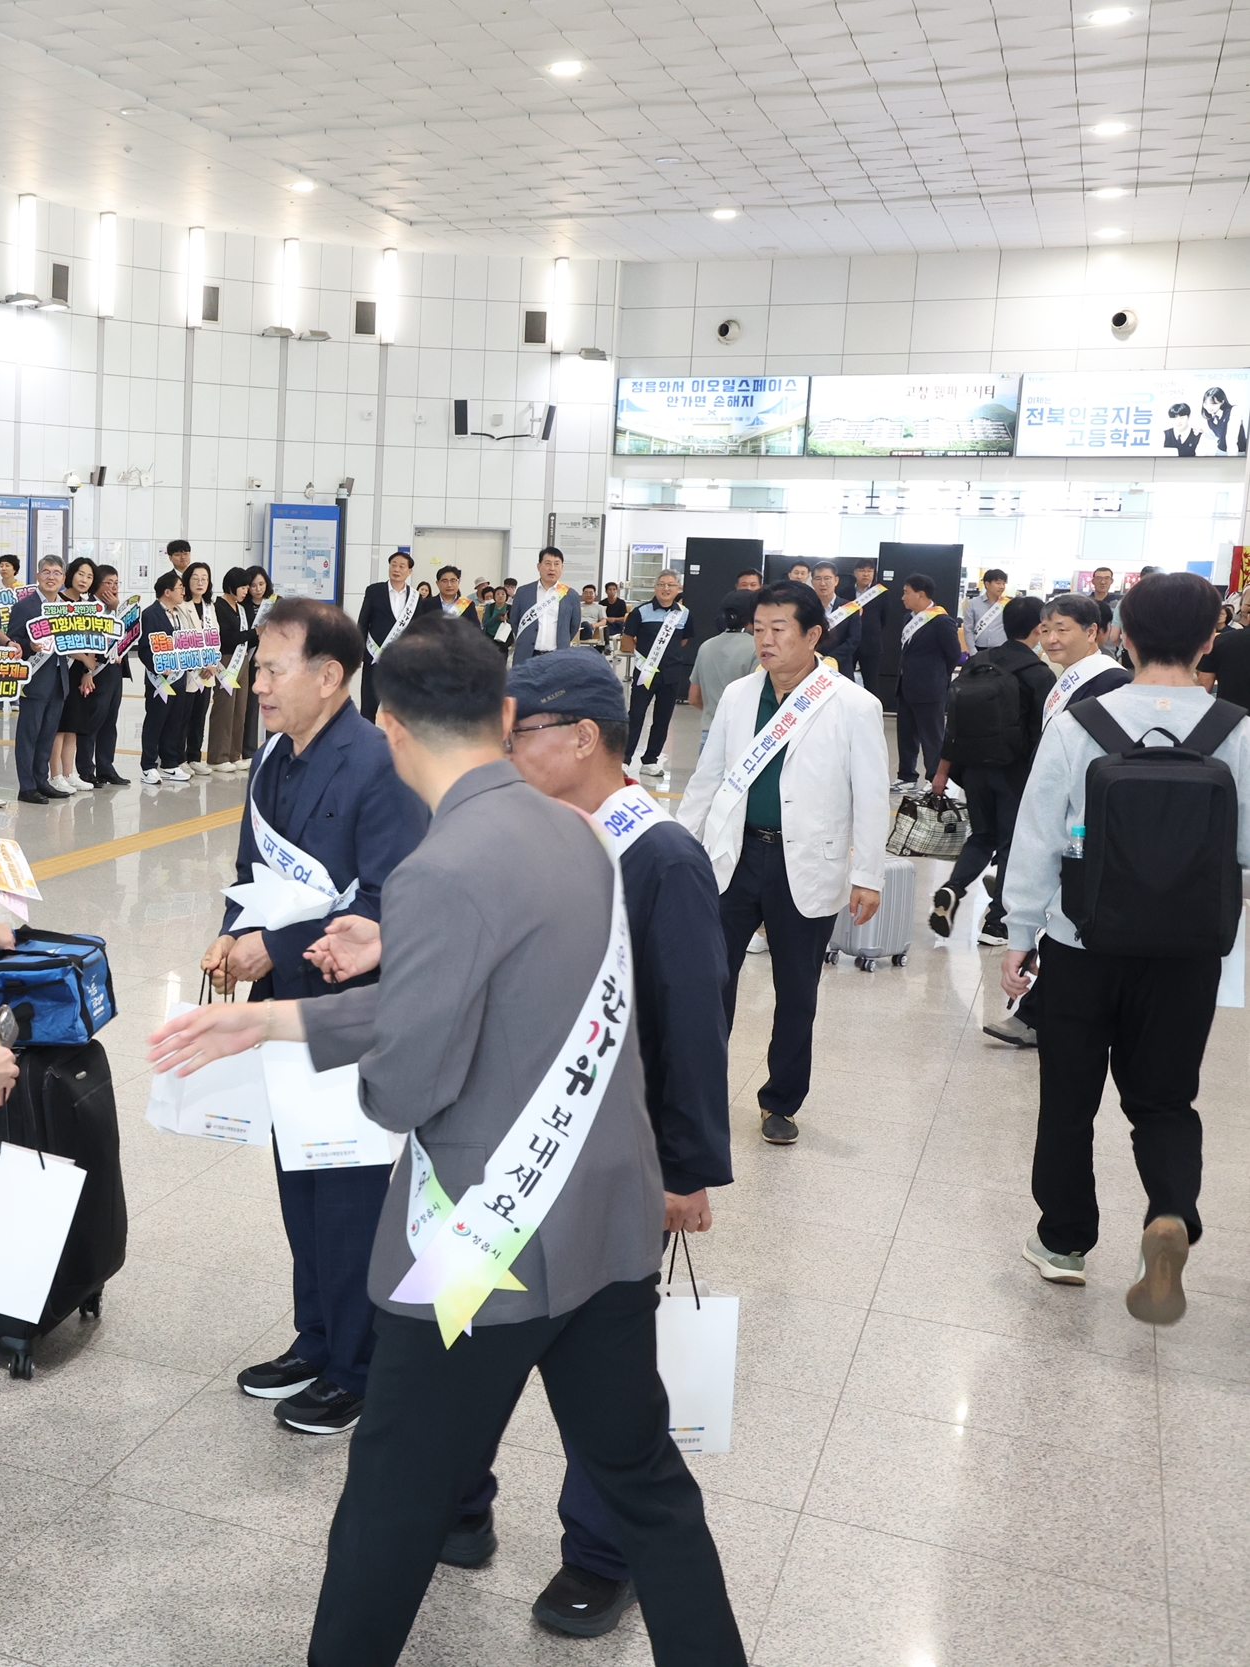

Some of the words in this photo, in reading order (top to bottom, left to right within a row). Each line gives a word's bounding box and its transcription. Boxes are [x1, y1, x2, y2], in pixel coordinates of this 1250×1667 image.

[691, 379, 797, 392] 이오일스페이스
[1208, 373, 1248, 381] 562-9703
[666, 396, 706, 408] 안가면
[714, 396, 754, 408] 손해지
[1026, 406, 1153, 426] 전북인공지능
[1066, 428, 1150, 448] 고등학교
[44, 606, 68, 615] 고향사랑
[74, 604, 97, 614] 착한기부
[56, 634, 106, 650] 응원합니다!
[150, 634, 174, 652] 정읍을
[174, 632, 204, 650] 사랑하는
[658, 624, 673, 644] 한가위
[154, 654, 178, 672] 영원히
[179, 651, 202, 669] 변하지
[1061, 670, 1080, 692] 고향
[794, 674, 833, 712] 방문을
[742, 712, 798, 775] 환영합니다
[604, 798, 654, 837] 고향
[566, 976, 626, 1097] 한가위
[483, 1104, 573, 1234] 보내세요.
[418, 1202, 442, 1224] 정읍시
[472, 1234, 502, 1260] 정읍시
